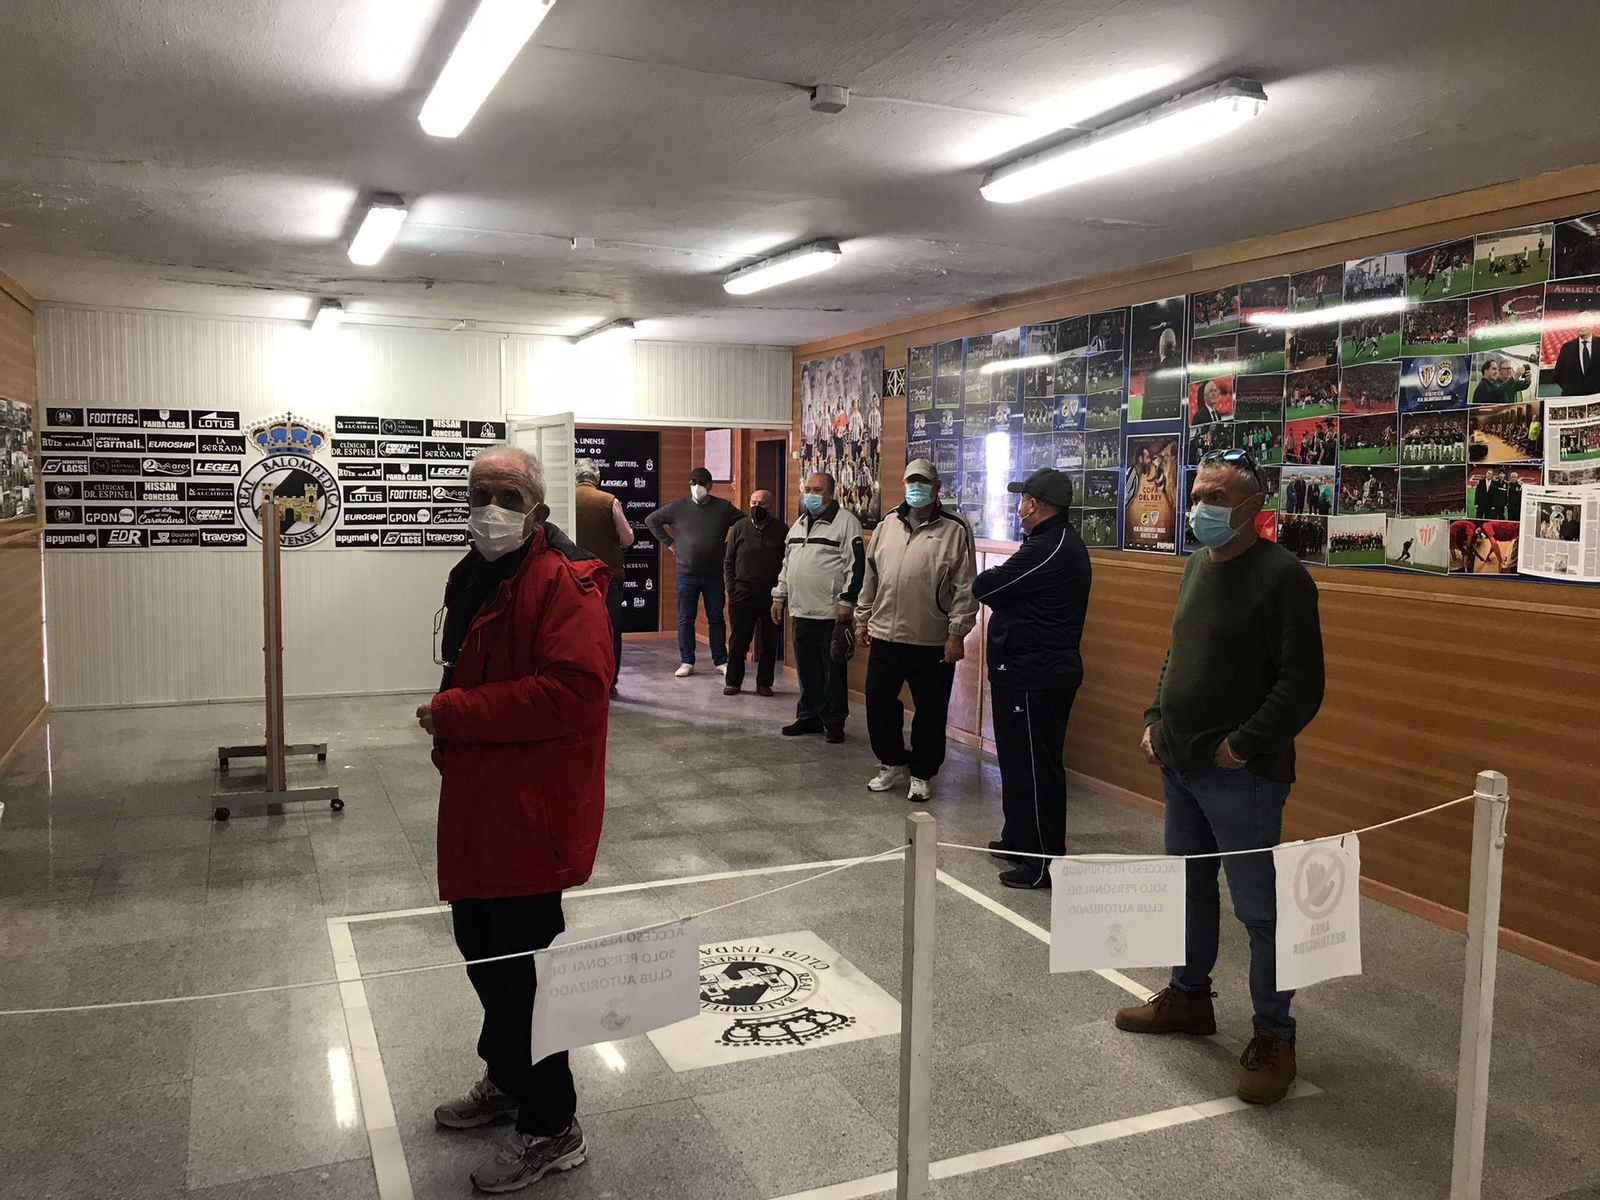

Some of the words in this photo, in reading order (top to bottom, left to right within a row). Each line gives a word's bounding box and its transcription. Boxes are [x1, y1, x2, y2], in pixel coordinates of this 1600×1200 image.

[1554, 285, 1594, 294] ATHLETIC
[89, 413, 138, 424] FOOTTERS.
[143, 420, 166, 428] PANDA
[167, 421, 186, 429] CARS
[198, 420, 235, 428] LOTUS
[433, 419, 461, 429] NISSAN
[41, 438, 62, 447] RUIZ
[95, 439, 141, 449] carmali
[148, 440, 195, 449] EUROSHIP
[62, 464, 88, 473] LACSE
[196, 463, 239, 472] LEGEA
[430, 467, 468, 476] LEGEA
[144, 482, 177, 491] NISSAN
[84, 491, 98, 499] DR.
[99, 491, 135, 499] ESPINEL
[143, 493, 179, 501] CONCESOL
[240, 480, 256, 508] REAL
[349, 494, 383, 502] LOTUS
[389, 489, 431, 499] FOOTTERS.
[85, 513, 117, 523] GPON
[138, 514, 185, 525] Carmelina
[344, 513, 387, 521] EUROSHIP
[389, 513, 416, 523] GPON
[433, 514, 470, 524] Carmelin
[46, 534, 86, 545] apymell
[108, 530, 142, 545] EDR
[201, 531, 246, 542] traverso
[336, 533, 370, 543] apymell
[426, 532, 465, 542] traverso
[699, 946, 775, 956] FUNDA
[782, 950, 830, 970] CLUB
[796, 972, 813, 992] REAL
